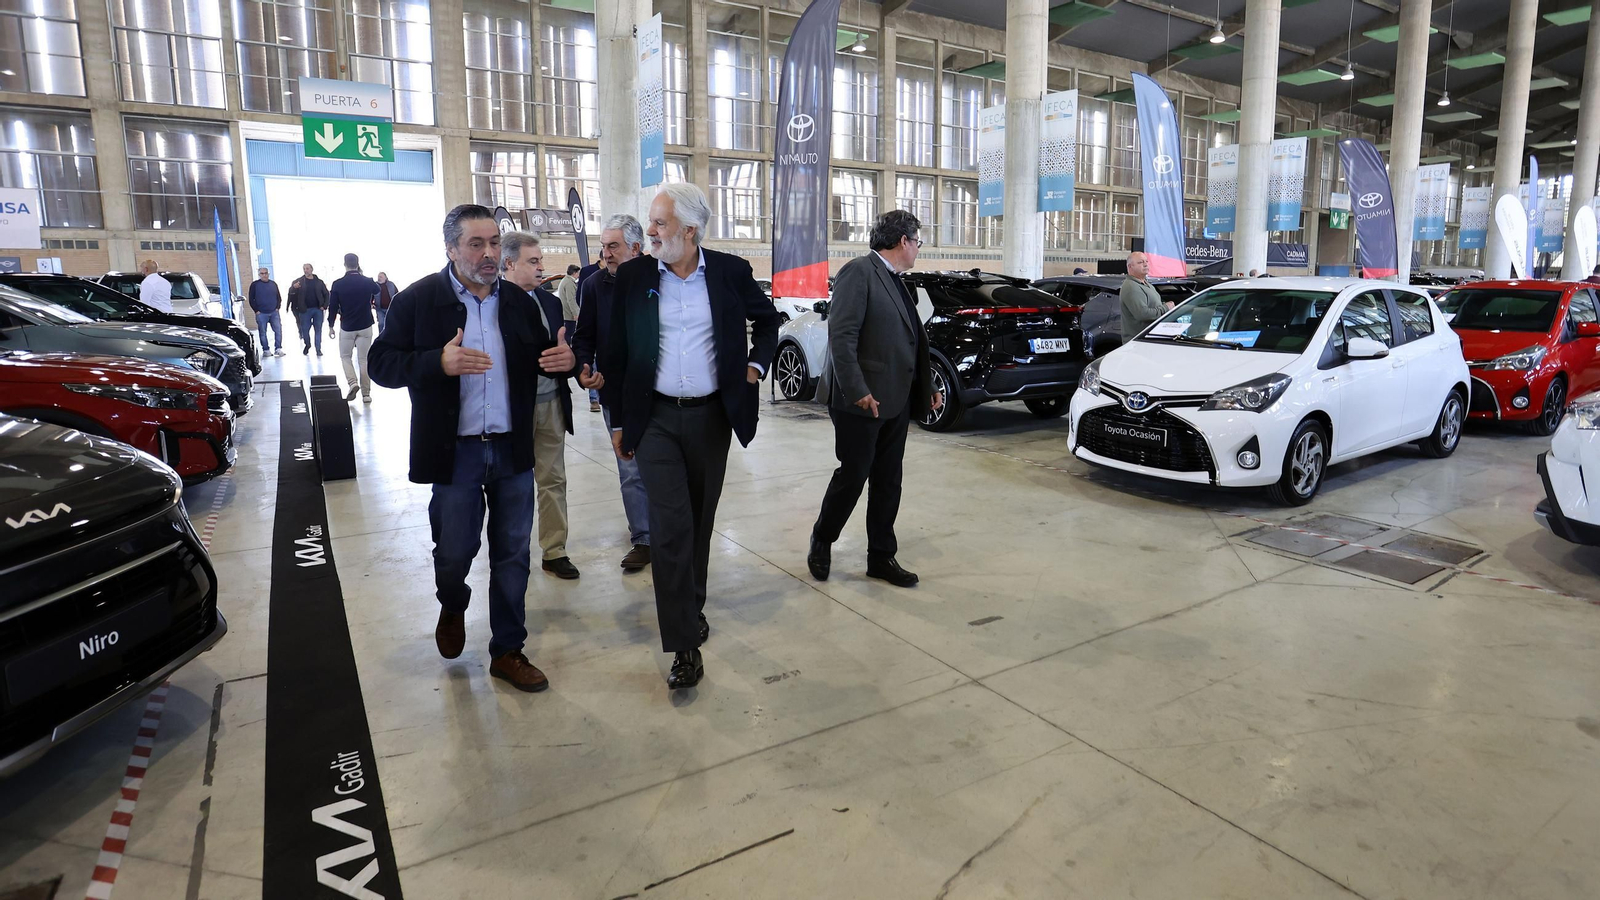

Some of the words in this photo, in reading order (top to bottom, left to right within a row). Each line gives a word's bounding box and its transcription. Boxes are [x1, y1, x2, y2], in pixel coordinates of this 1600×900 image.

[314, 94, 362, 107] PUERTA
[370, 99, 378, 109] 6
[1044, 100, 1074, 113] IFECA
[981, 113, 1006, 126] IFECA
[1273, 144, 1303, 154] IFECA
[1210, 151, 1237, 162] IFECA
[1420, 169, 1446, 178] IFECA
[1185, 244, 1229, 258] cedes-Benz
[1054, 340, 1068, 349] MNY
[1103, 423, 1128, 435] Toyota
[1128, 428, 1161, 441] Ocasión
[5, 502, 72, 529] KIA
[79, 631, 119, 660] Niro
[330, 750, 365, 795] Gadir
